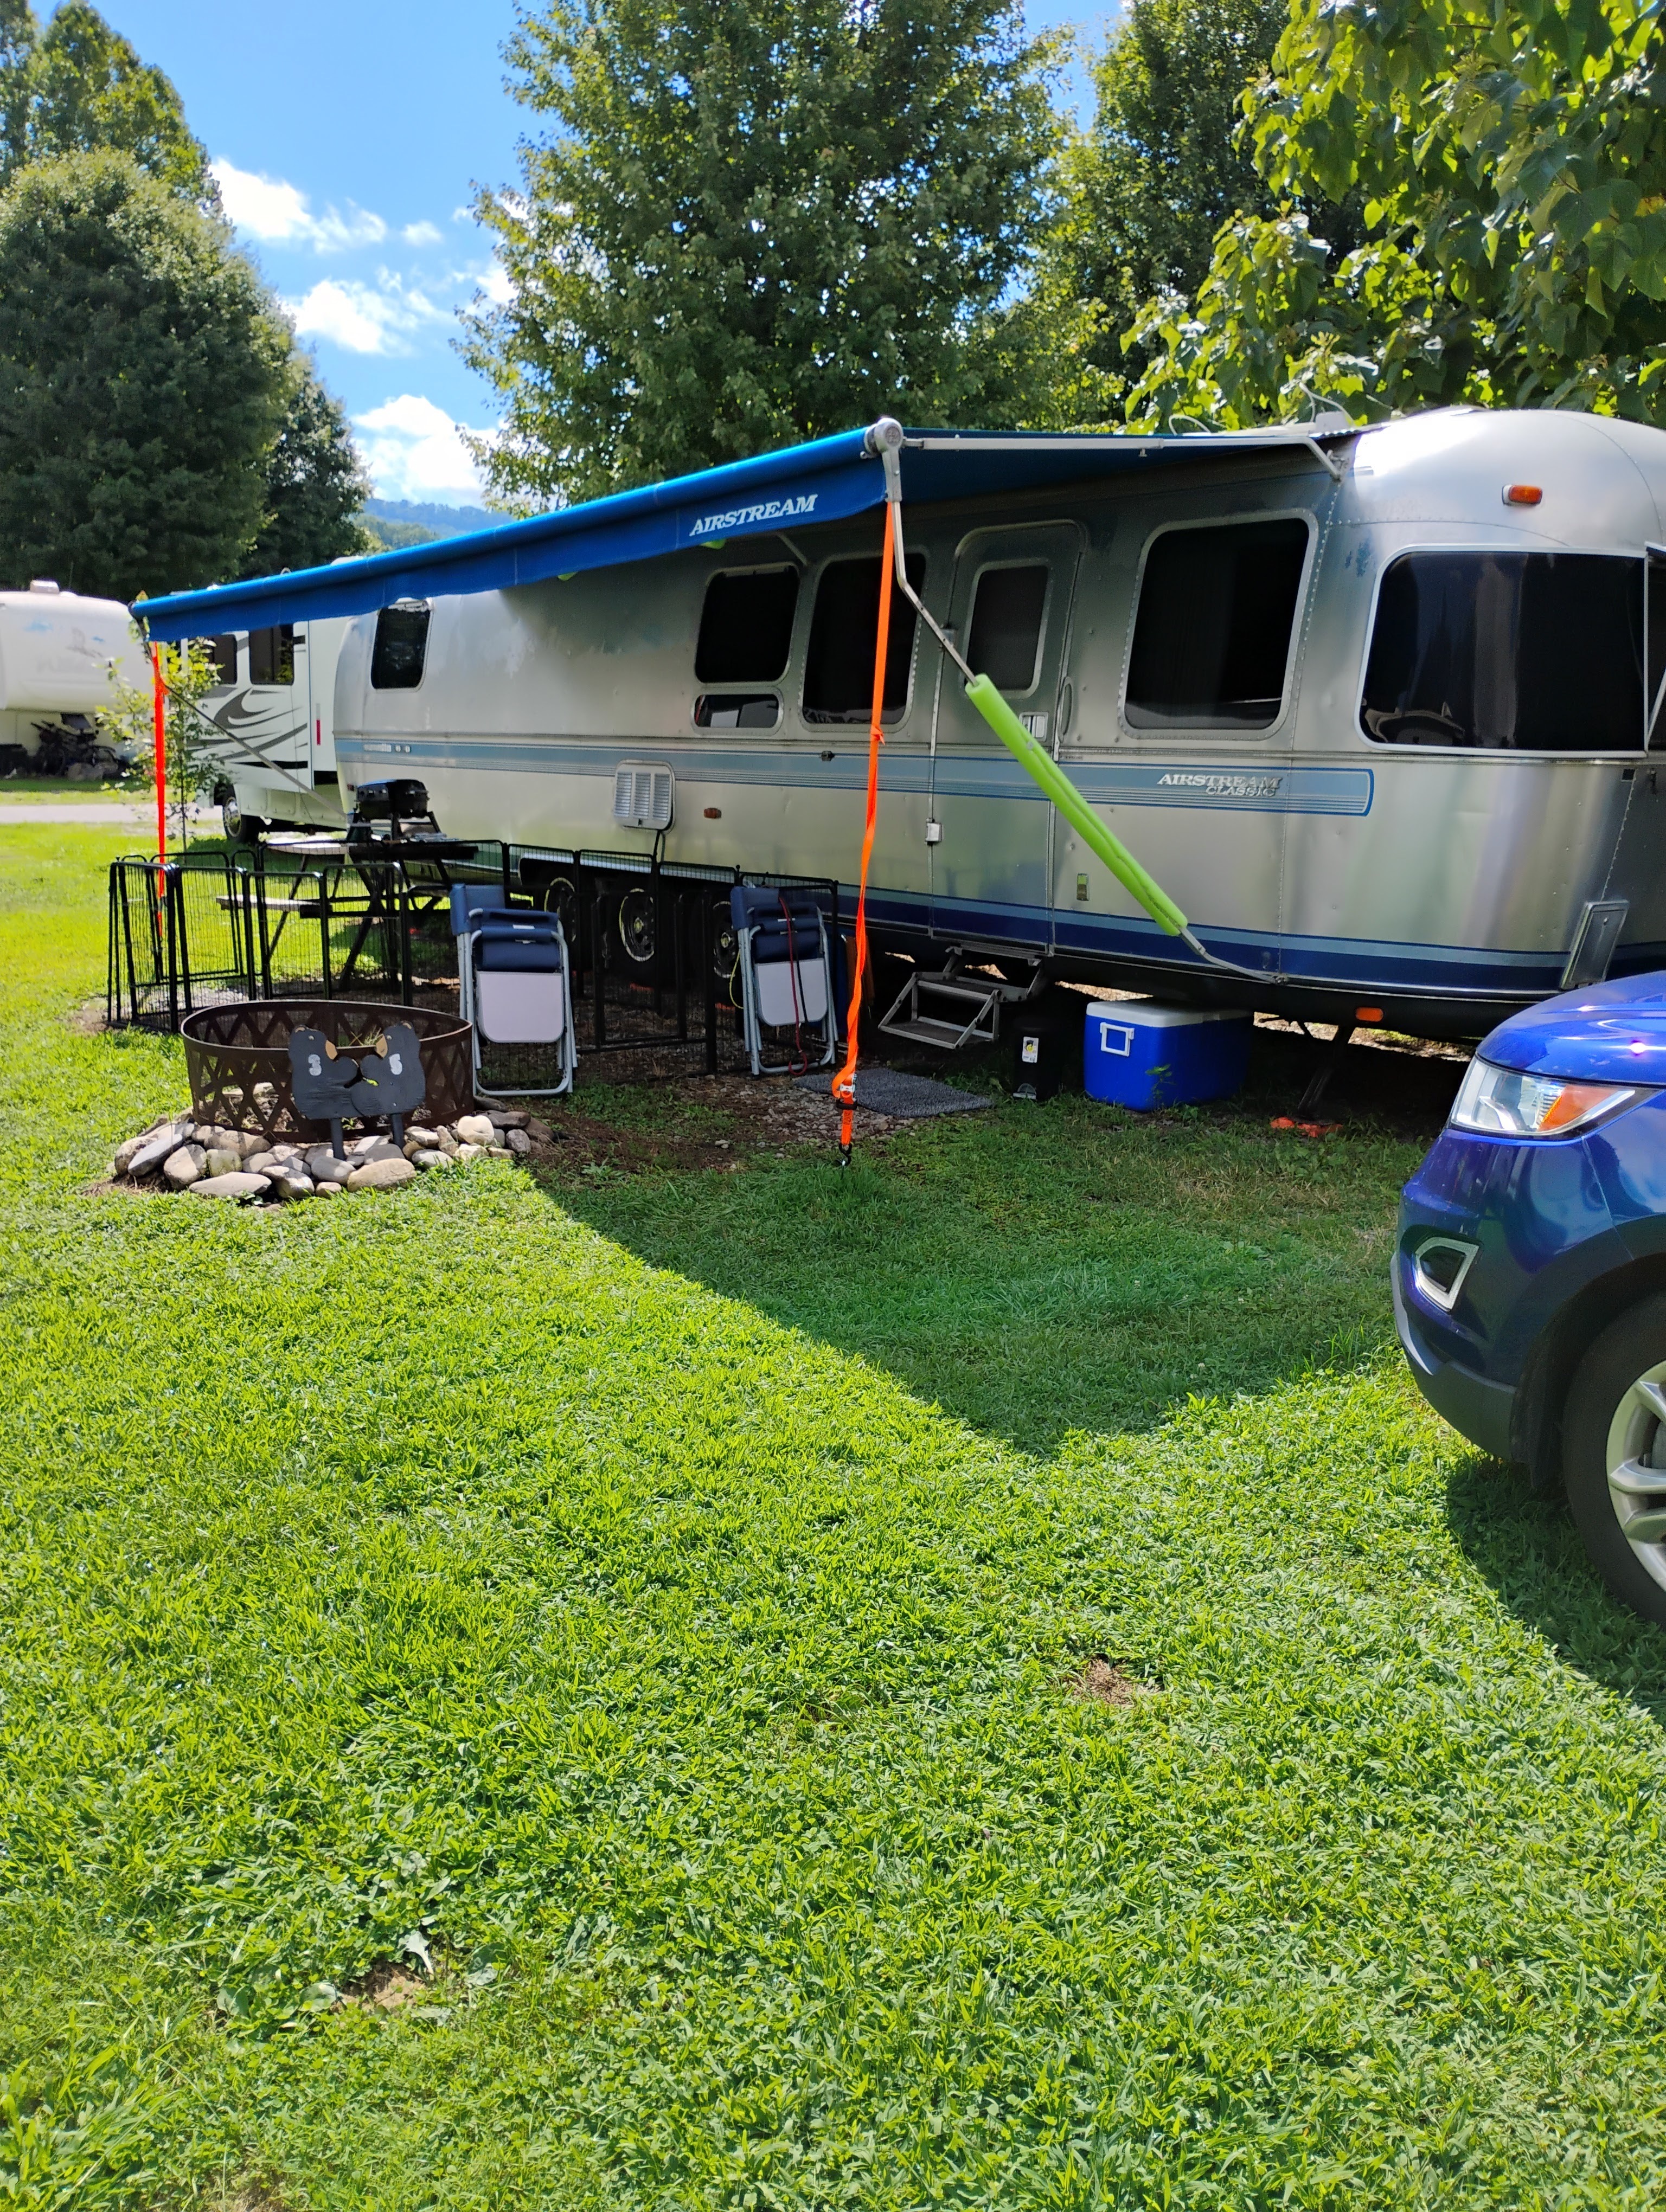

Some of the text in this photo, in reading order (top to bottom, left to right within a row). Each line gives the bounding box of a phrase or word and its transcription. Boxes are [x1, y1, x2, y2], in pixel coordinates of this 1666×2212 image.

[689, 494, 818, 536] AIRSTREAM
[1157, 774, 1283, 788] AIRSTREAM
[1206, 786, 1276, 797] CLASSIC
